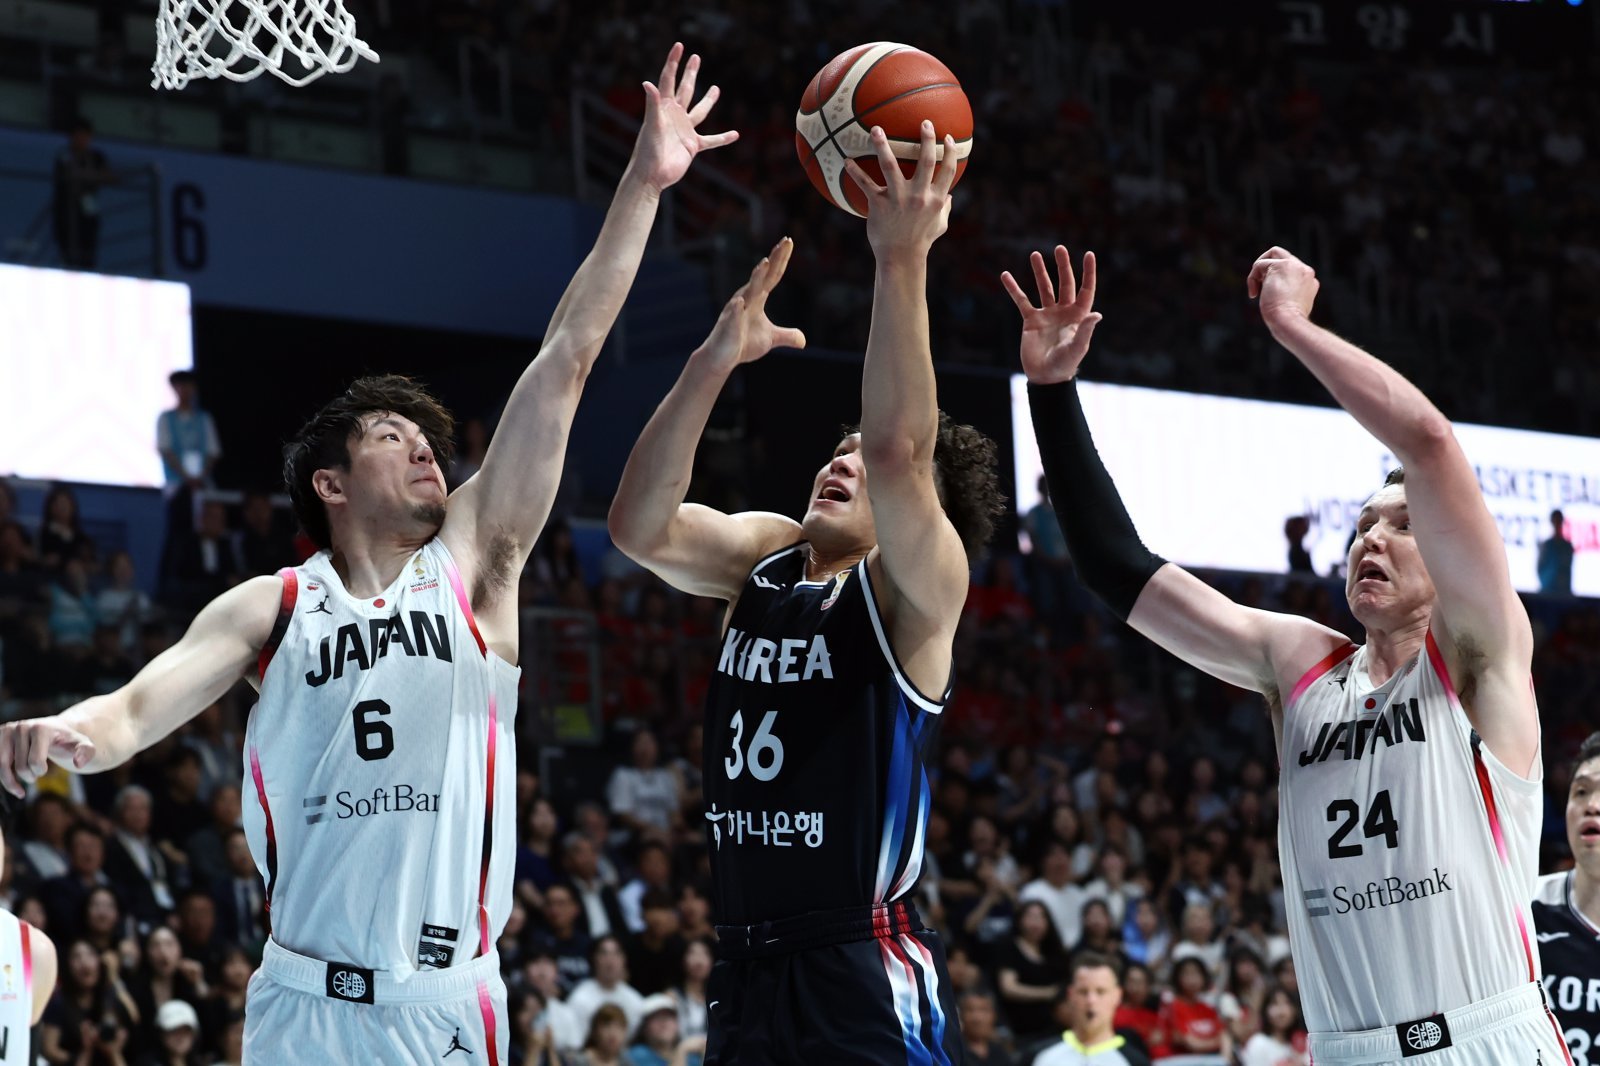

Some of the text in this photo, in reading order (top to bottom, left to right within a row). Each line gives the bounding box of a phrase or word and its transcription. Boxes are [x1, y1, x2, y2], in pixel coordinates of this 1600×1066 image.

[171, 183, 208, 272] 6
[305, 610, 453, 688] JAPAN
[352, 698, 394, 761] 6
[725, 709, 784, 782] 36
[1298, 697, 1426, 768] JAPAN
[727, 810, 823, 848] 하나은행
[1326, 789, 1399, 860] 24
[1333, 867, 1452, 914] SoftBank
[1564, 1027, 1600, 1066] 3
